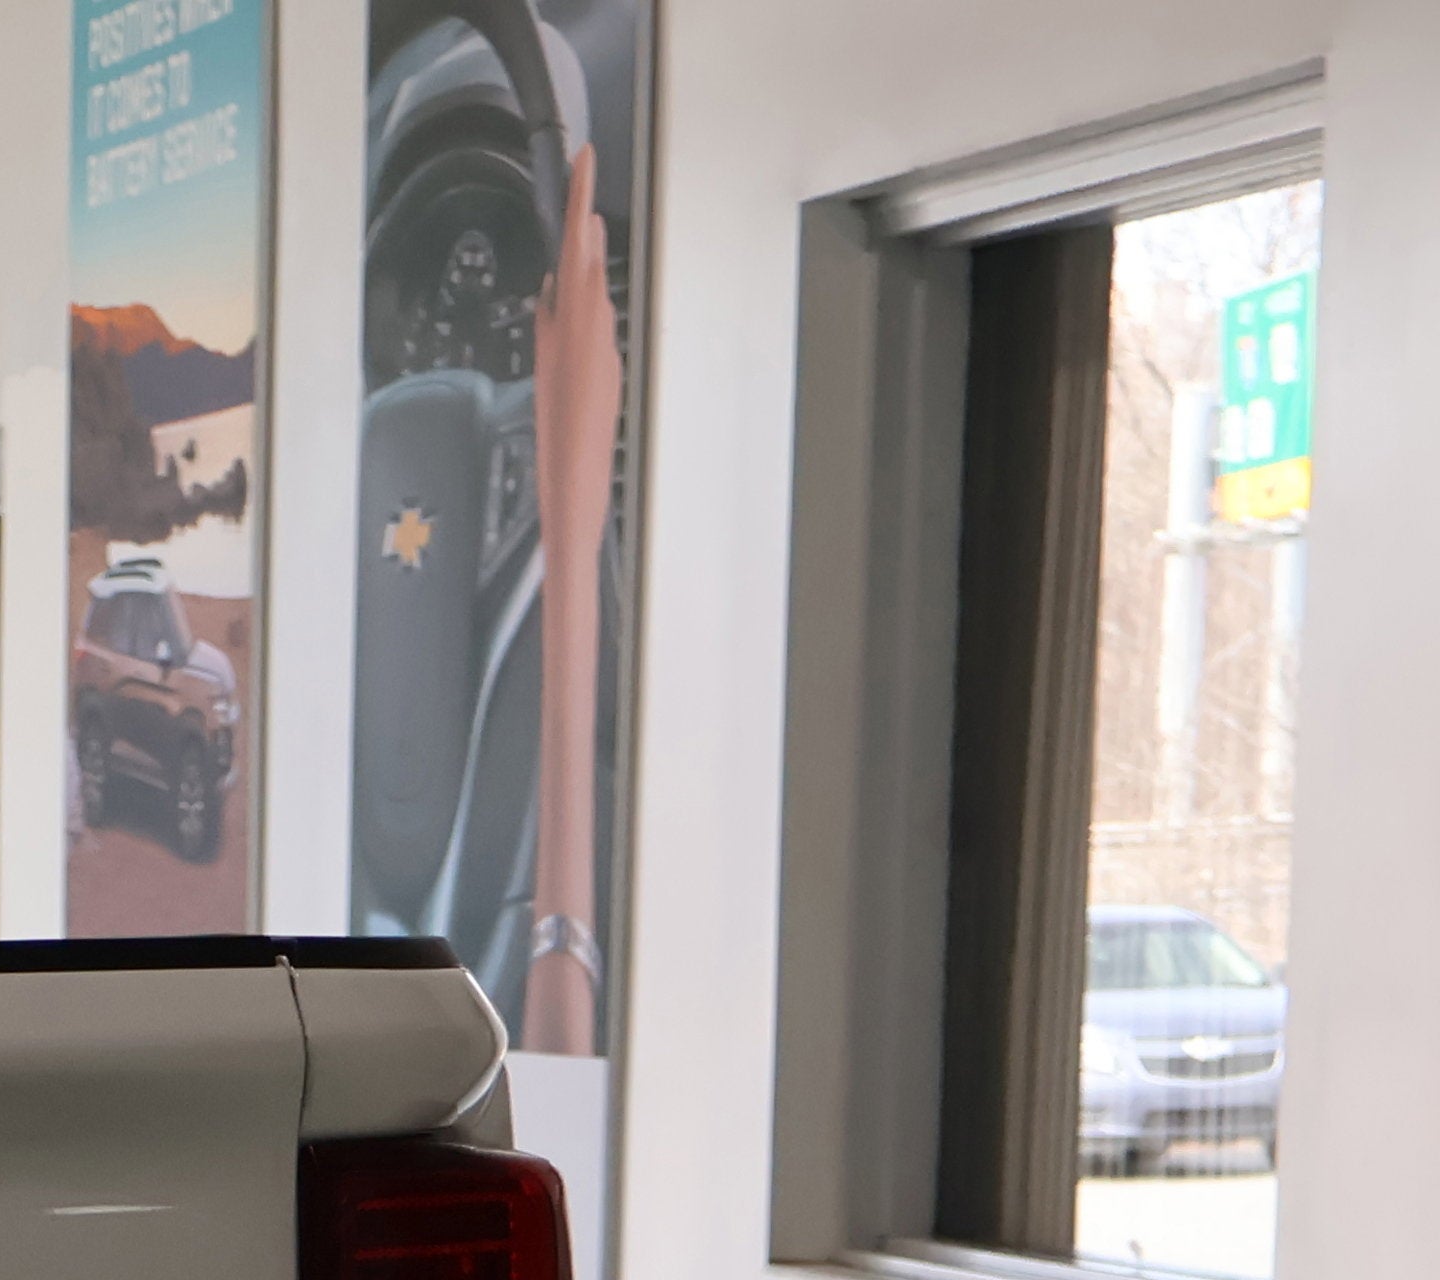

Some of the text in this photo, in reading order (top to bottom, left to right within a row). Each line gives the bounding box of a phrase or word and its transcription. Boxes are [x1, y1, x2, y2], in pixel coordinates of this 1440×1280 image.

[88, 0, 175, 70] POSITIVES
[88, 52, 191, 139] IT COMES TO
[87, 103, 239, 206] BATTERY SERVICE
